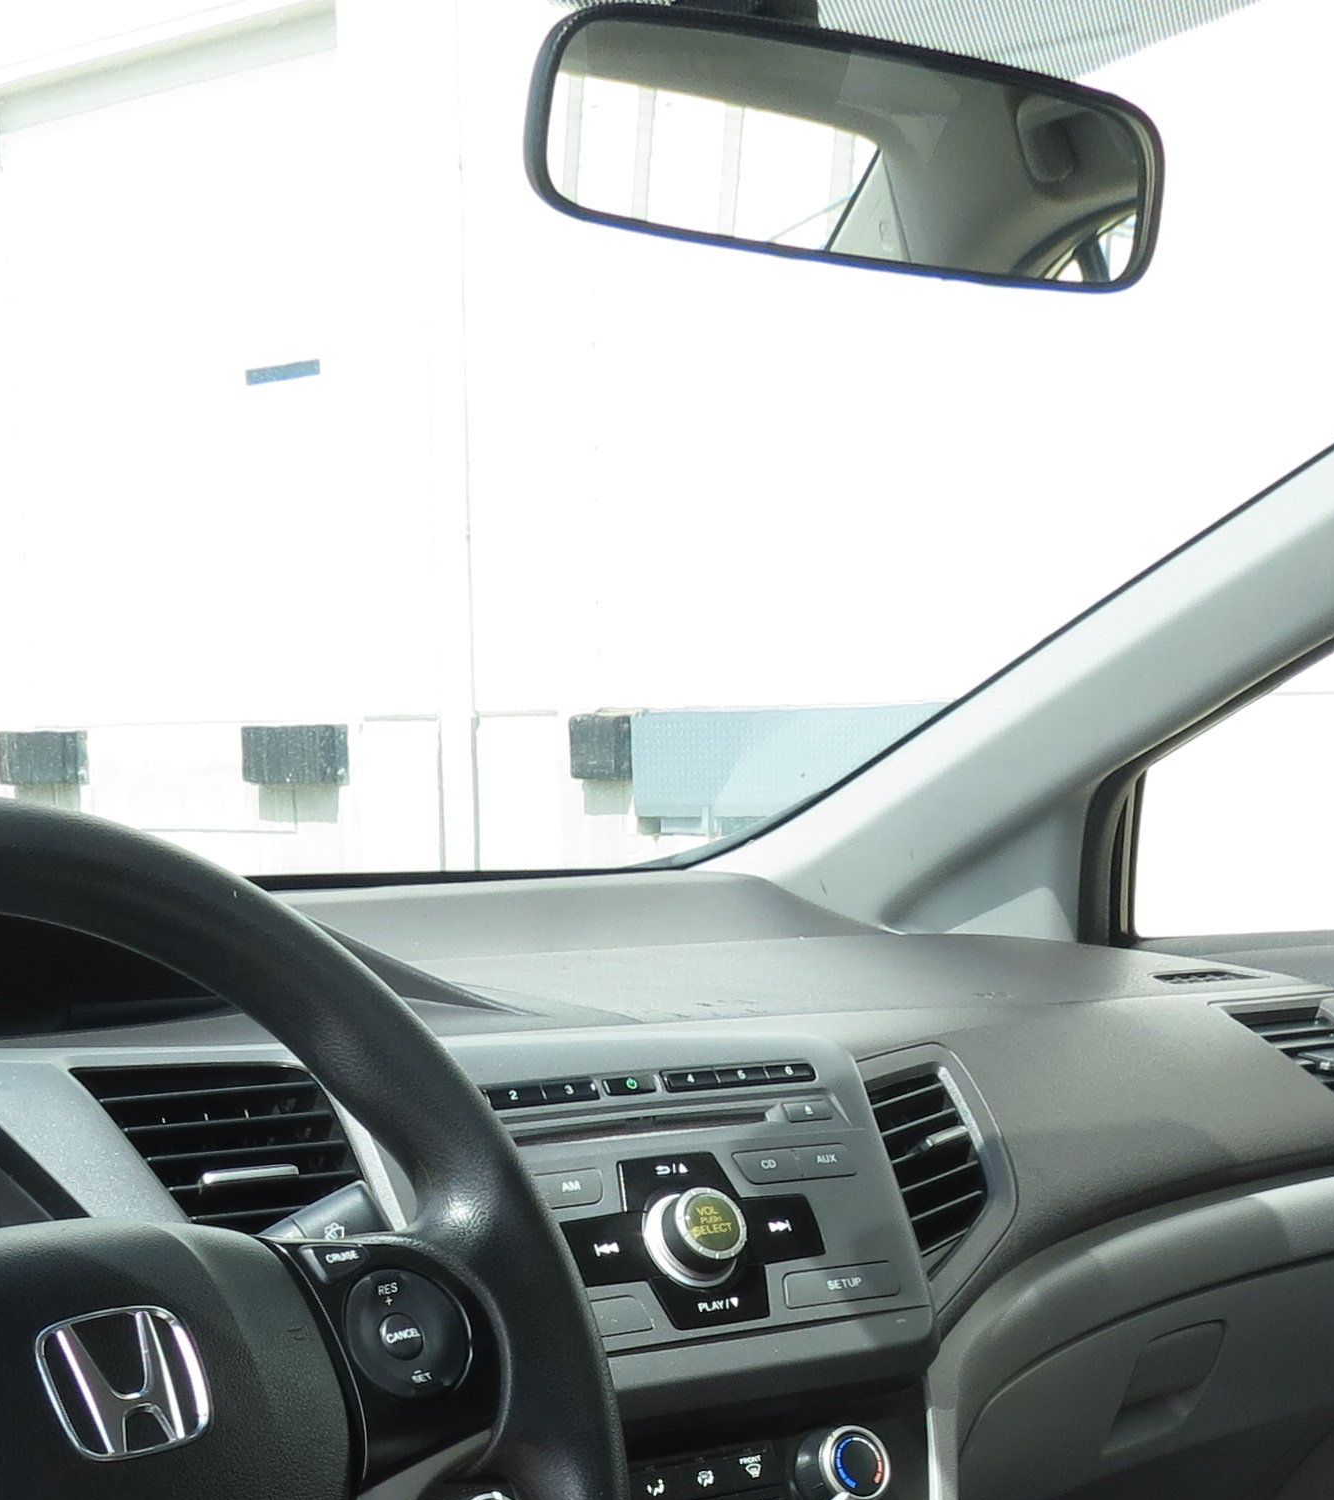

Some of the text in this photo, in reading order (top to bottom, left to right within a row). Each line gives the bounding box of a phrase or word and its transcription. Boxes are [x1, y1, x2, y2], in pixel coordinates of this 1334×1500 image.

[508, 1066, 794, 1100] 2 3 4 5 6
[760, 1153, 837, 1169] CD AUX
[561, 1180, 582, 1192] AM
[695, 1205, 719, 1215] VOL
[692, 1222, 732, 1237] SELECT
[325, 1250, 360, 1264] CRUISE
[378, 1282, 398, 1296] RES
[827, 1277, 862, 1290] SETUP
[386, 1327, 421, 1345] CANCEL
[411, 1372, 432, 1384] SET
[738, 1454, 761, 1465] FRONT
